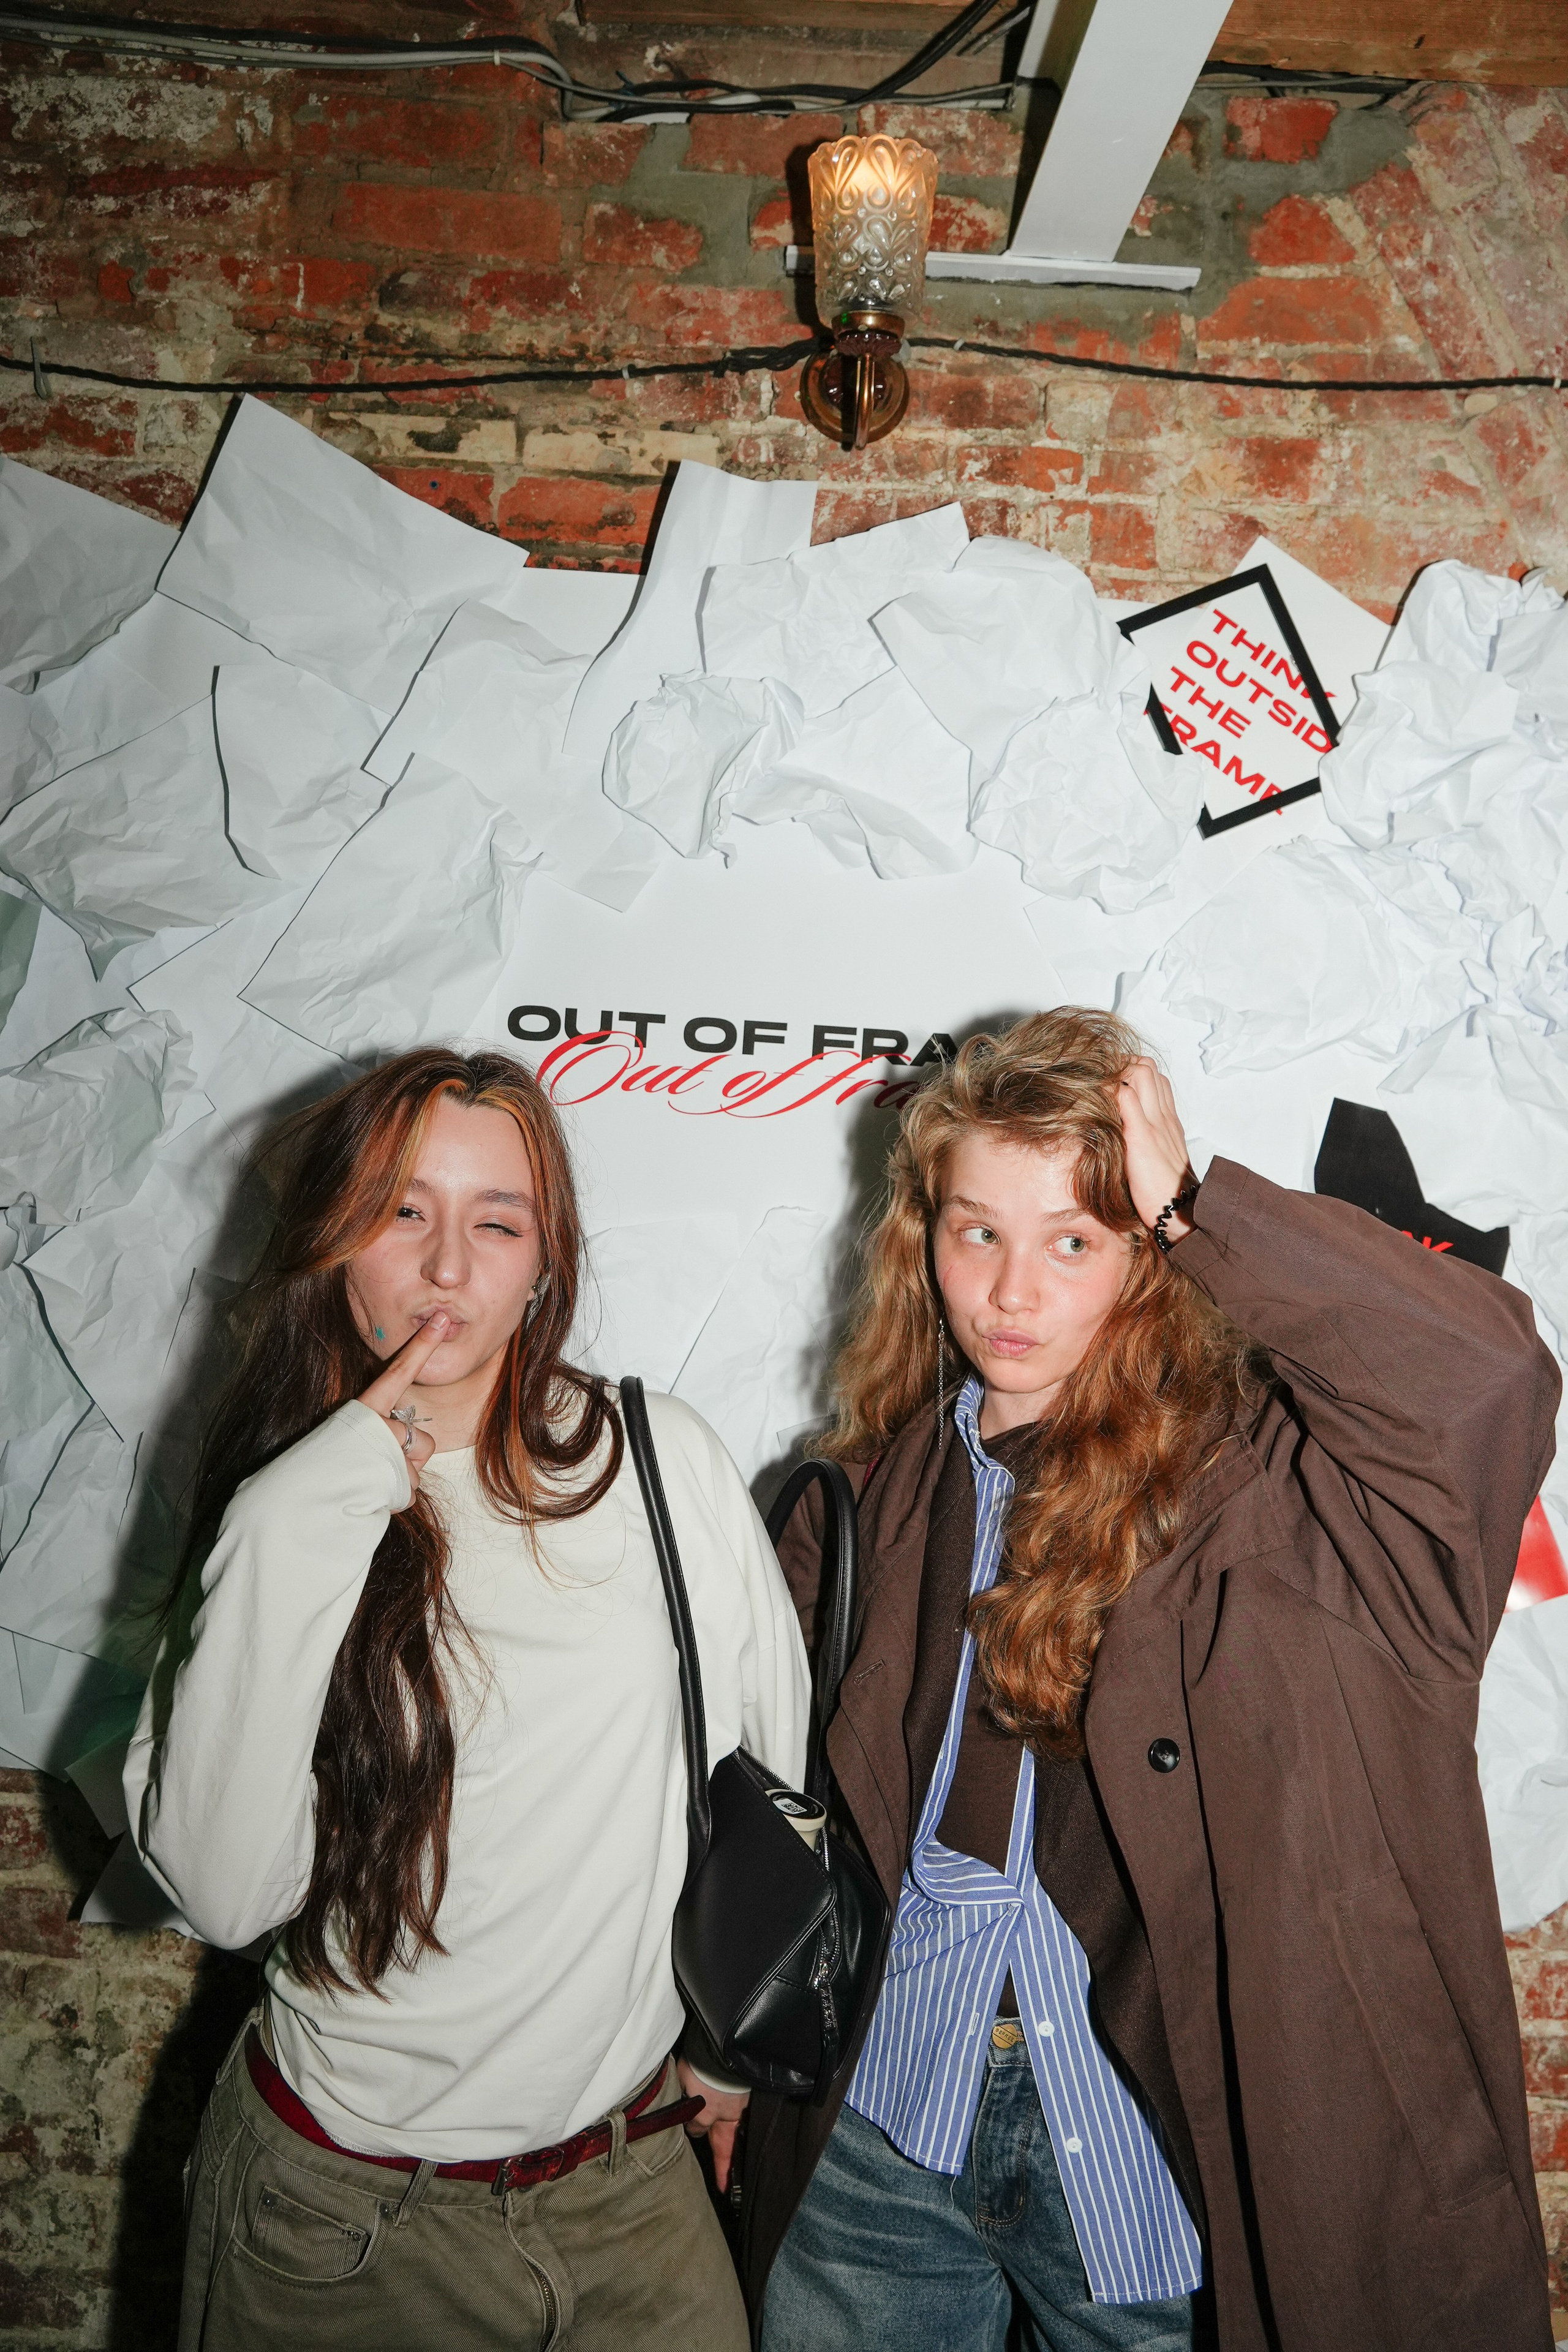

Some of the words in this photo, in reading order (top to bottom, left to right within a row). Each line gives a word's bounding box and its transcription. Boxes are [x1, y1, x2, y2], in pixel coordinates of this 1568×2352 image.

[1170, 666, 1252, 739] THE
[507, 1005, 666, 1047] OUT
[683, 1017, 788, 1055] OF
[536, 1030, 732, 1106] Out
[995, 2028, 1014, 2043] BEFREE
